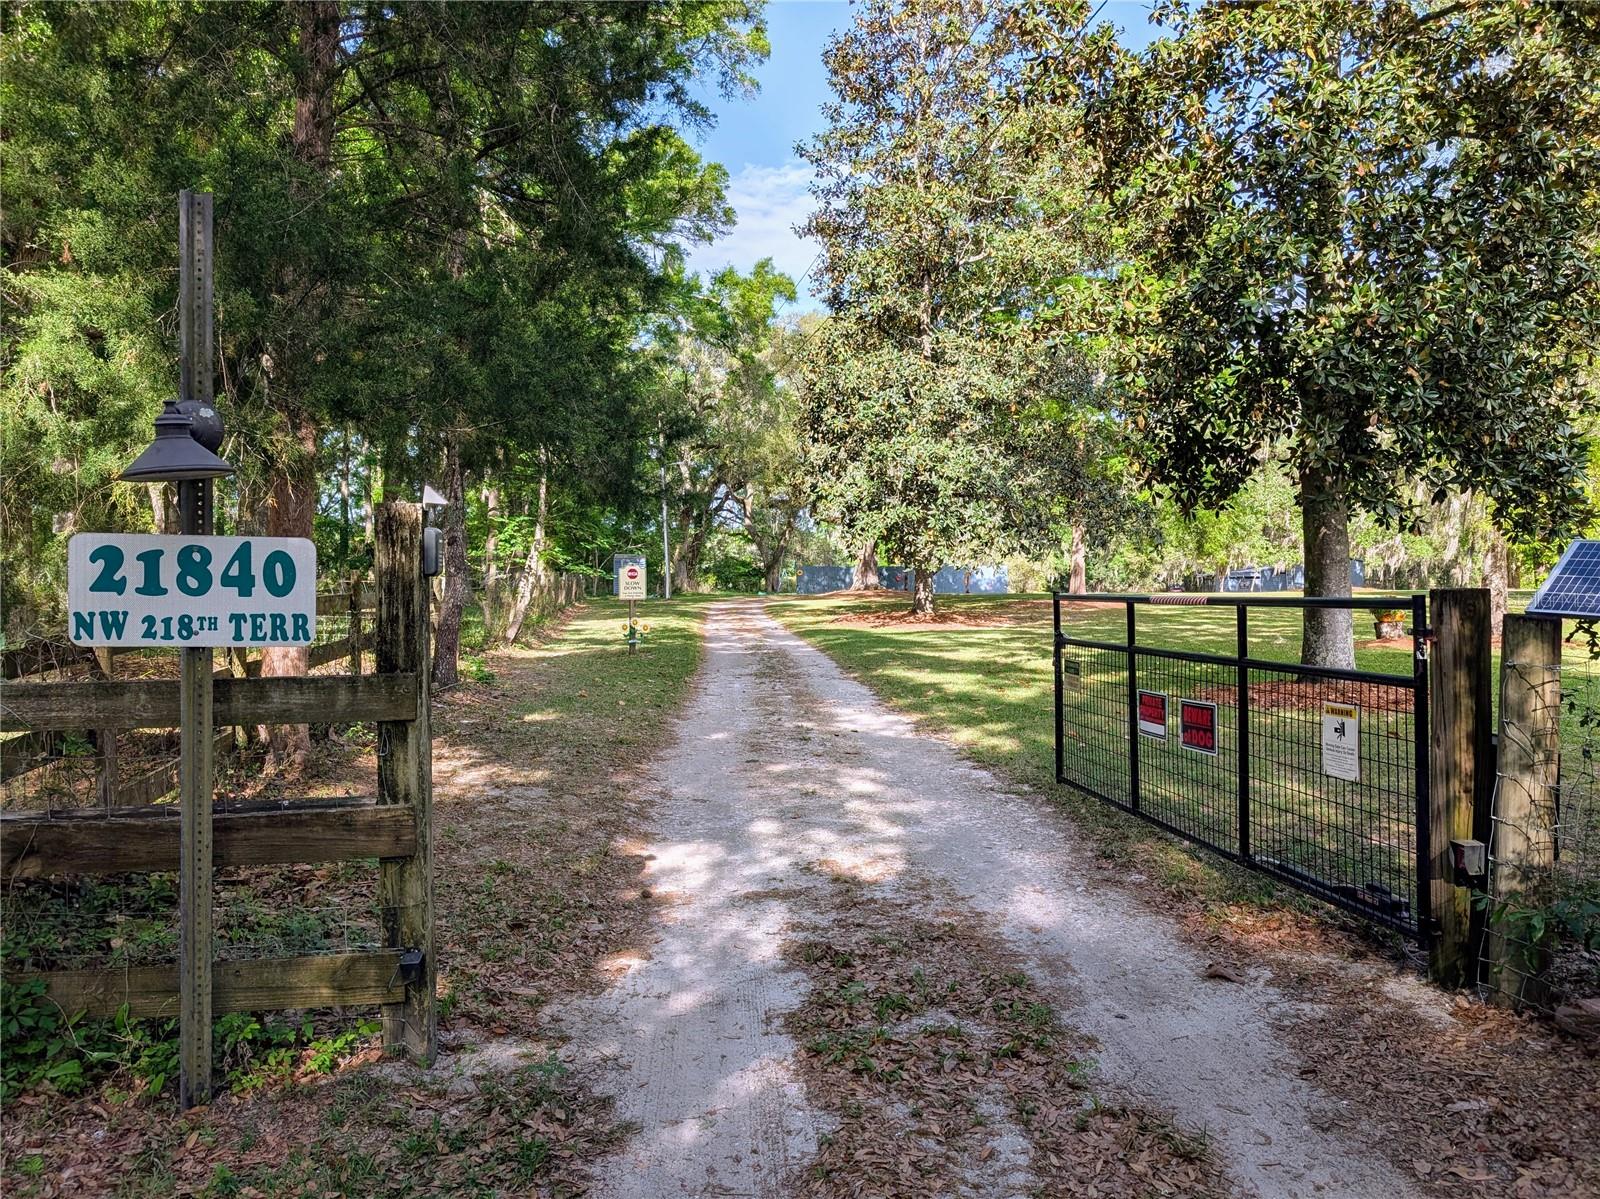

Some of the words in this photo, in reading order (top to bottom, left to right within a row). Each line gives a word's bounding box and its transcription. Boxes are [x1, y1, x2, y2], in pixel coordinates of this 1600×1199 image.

[88, 540, 297, 598] 21840
[73, 611, 129, 641] NW
[228, 613, 311, 642] TERR
[1184, 706, 1212, 726] BEWARE
[1330, 706, 1353, 718] WARNING
[1192, 729, 1213, 748] DOG
